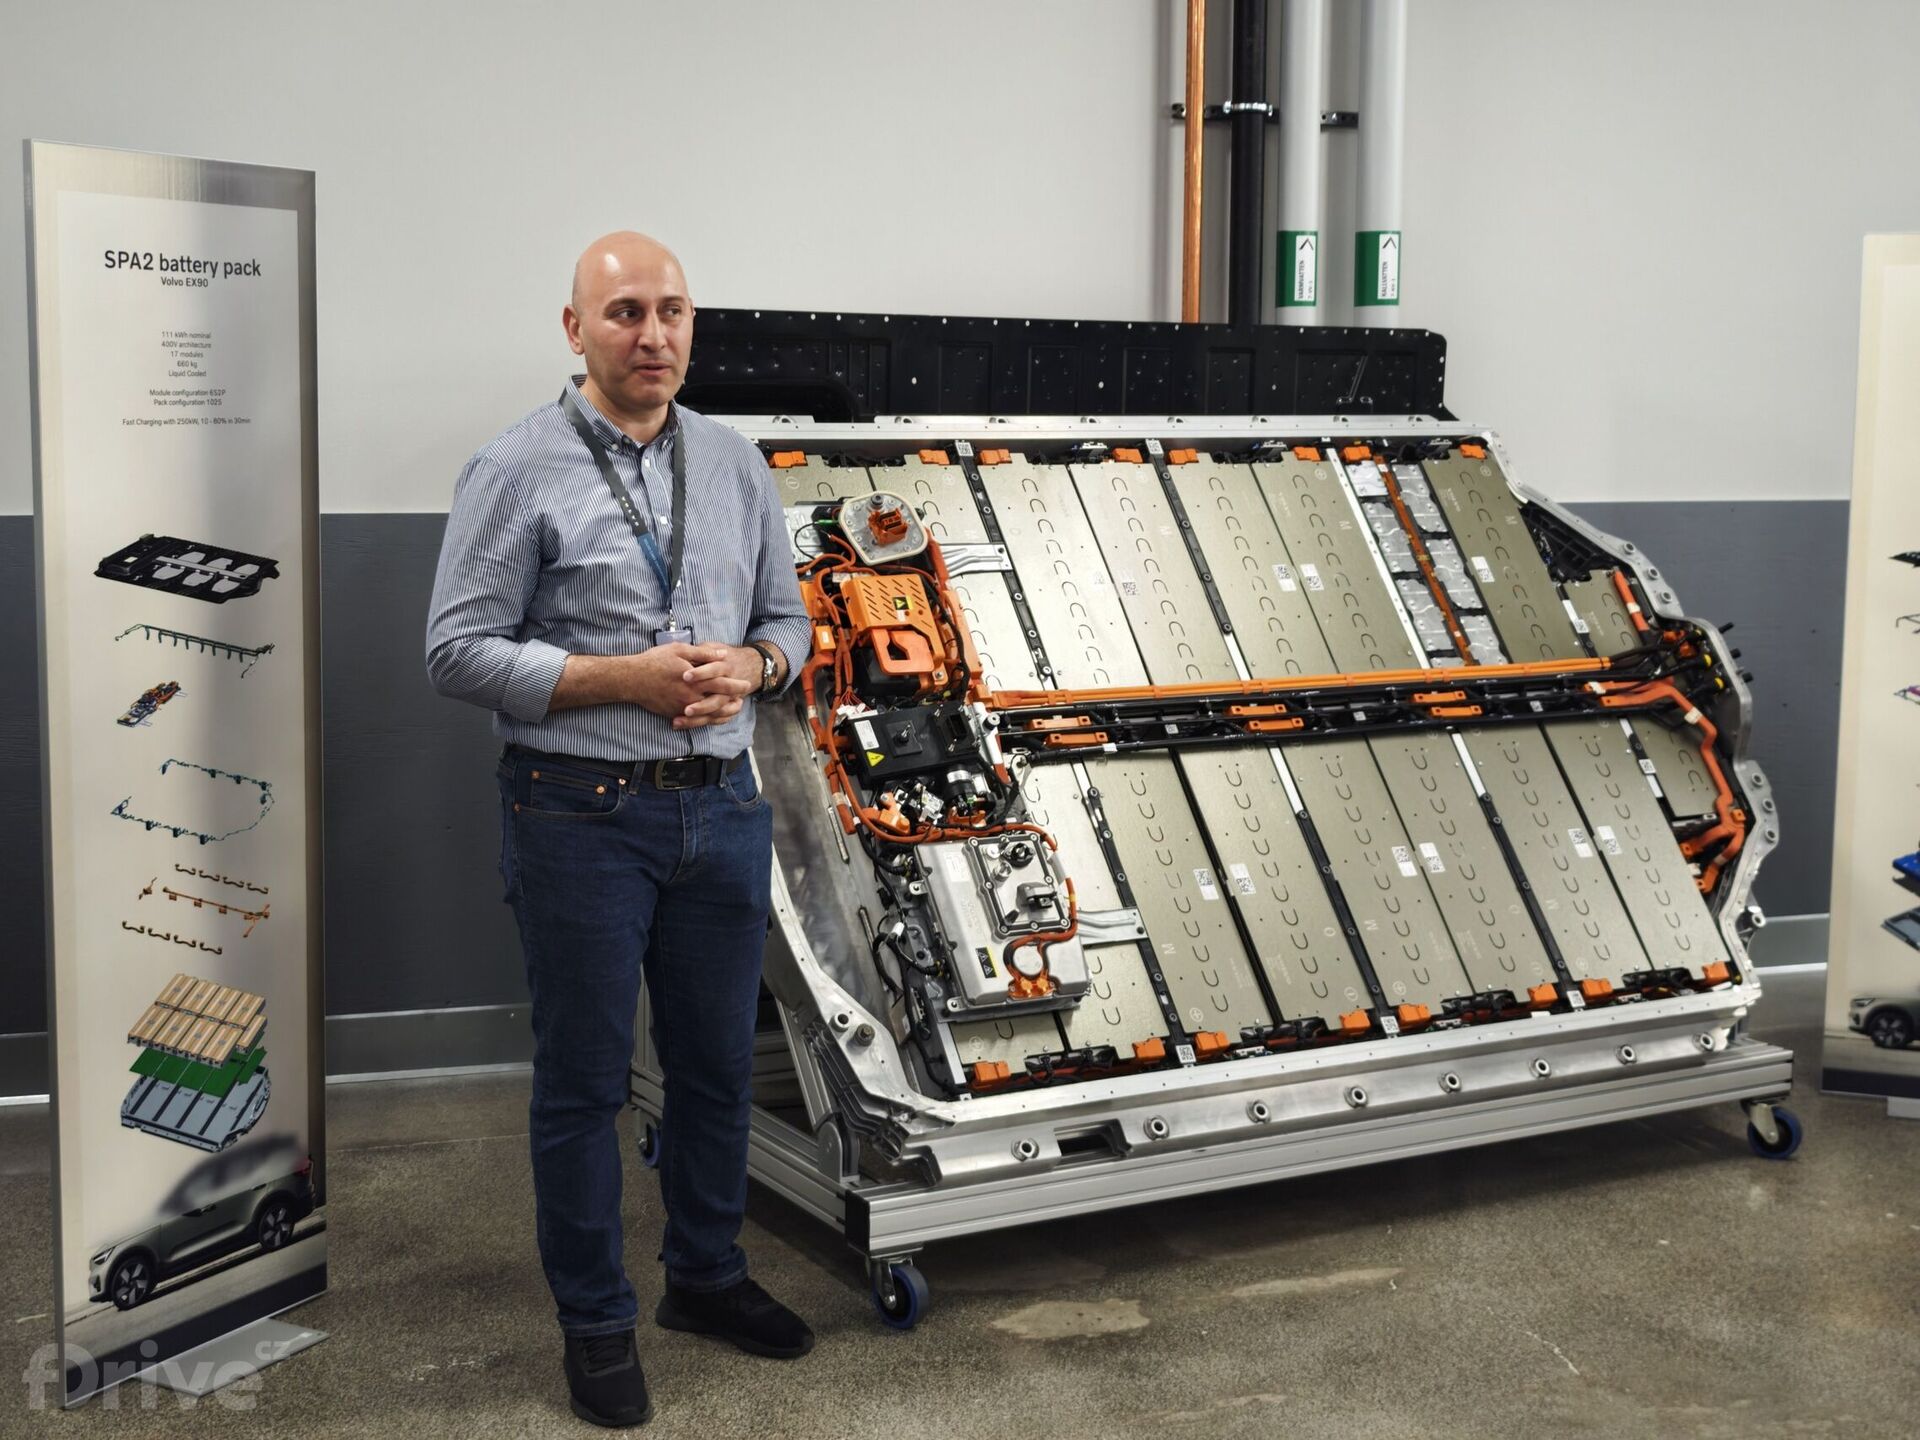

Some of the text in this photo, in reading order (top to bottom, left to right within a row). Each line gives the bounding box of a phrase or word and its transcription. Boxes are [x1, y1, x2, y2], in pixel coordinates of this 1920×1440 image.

[104, 250, 262, 279] SPA2 battery pack
[160, 276, 208, 288] Volvo EX90
[170, 350, 179, 358] 17
[190, 360, 198, 369] kg
[171, 389, 208, 398] configuration
[168, 399, 205, 407] configuration
[135, 418, 162, 427] Charging
